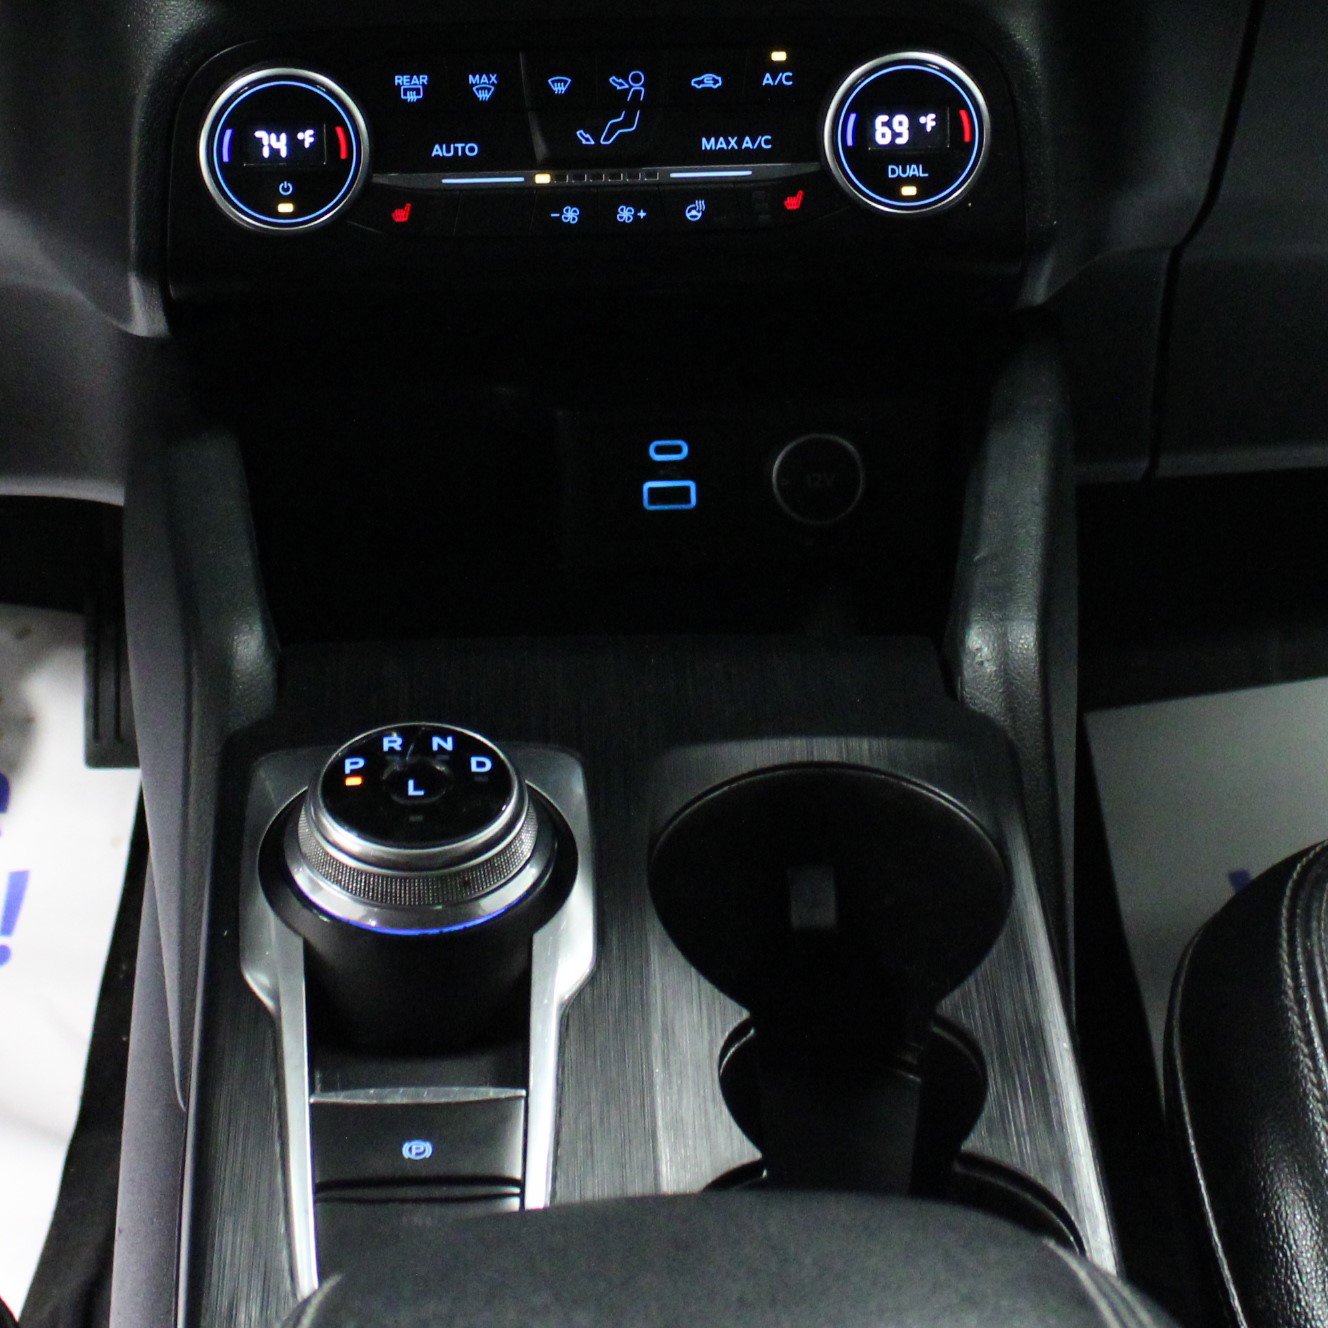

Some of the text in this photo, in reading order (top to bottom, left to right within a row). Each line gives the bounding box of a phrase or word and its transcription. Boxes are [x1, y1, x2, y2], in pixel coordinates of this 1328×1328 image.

[394, 74, 428, 86] REAR
[468, 73, 498, 85] MAX
[762, 71, 793, 86] A/C
[874, 113, 910, 145] 69
[254, 129, 287, 159] 74
[431, 142, 478, 157] AUTO
[701, 135, 772, 150] MAX A/C
[888, 164, 929, 179] DUAL
[344, 736, 492, 774] P R N D
[407, 779, 425, 797] L
